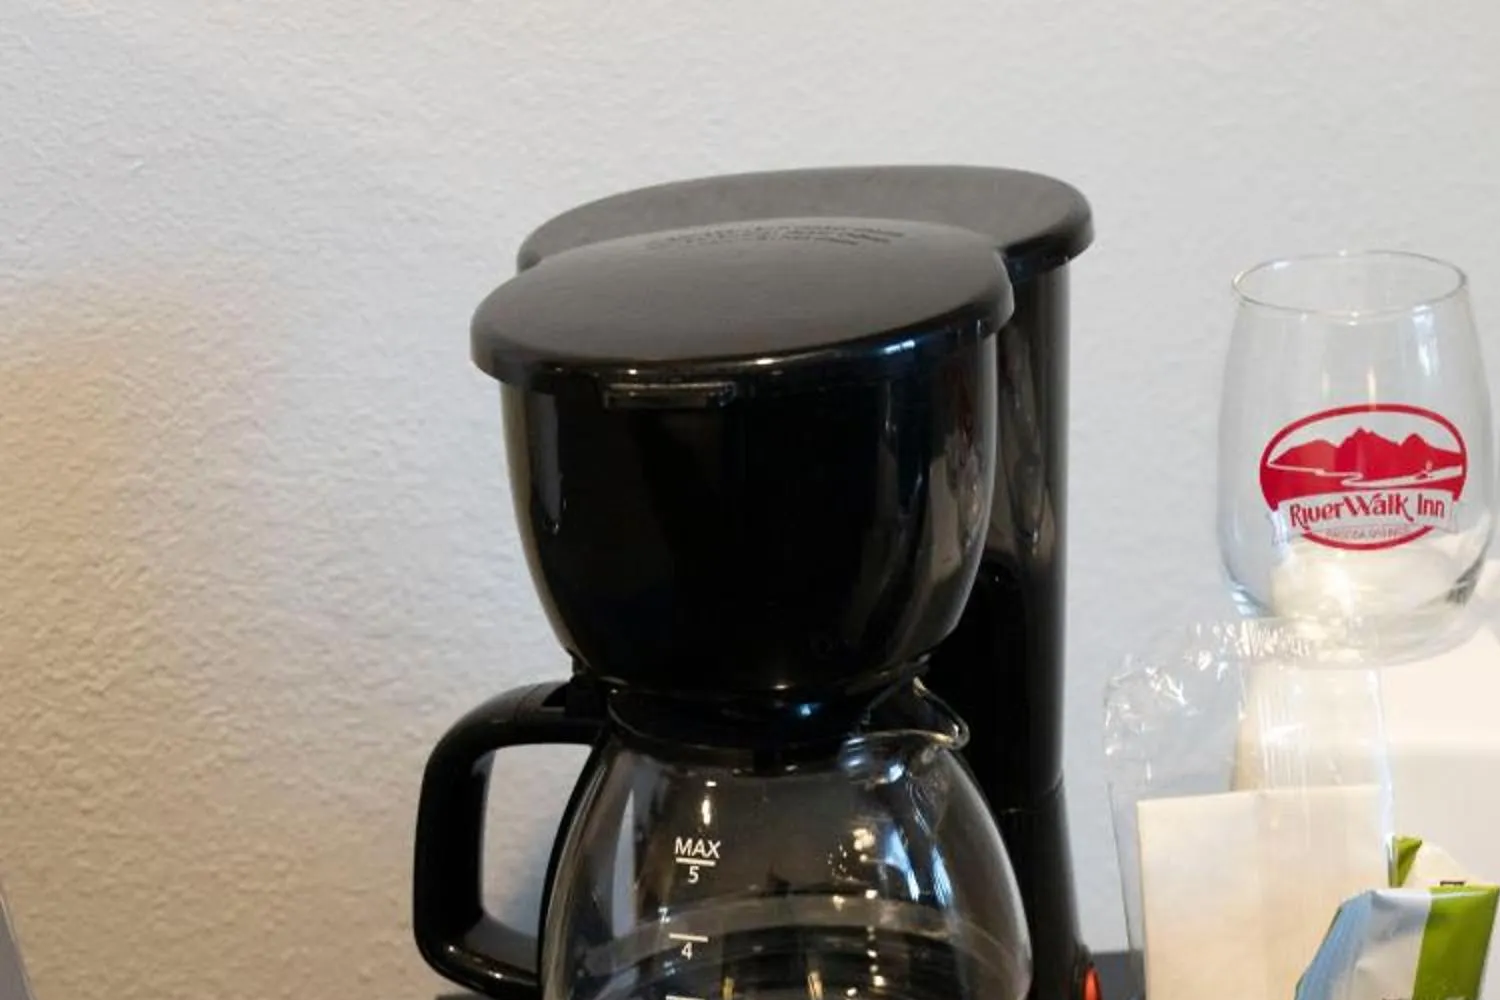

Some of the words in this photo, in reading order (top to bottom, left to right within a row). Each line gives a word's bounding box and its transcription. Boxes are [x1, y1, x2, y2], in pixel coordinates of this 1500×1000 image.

[1289, 491, 1416, 530] RiverWalk
[1417, 492, 1446, 519] Inn
[673, 836, 721, 859] MAX
[688, 866, 700, 885] 5
[680, 942, 693, 961] 4
